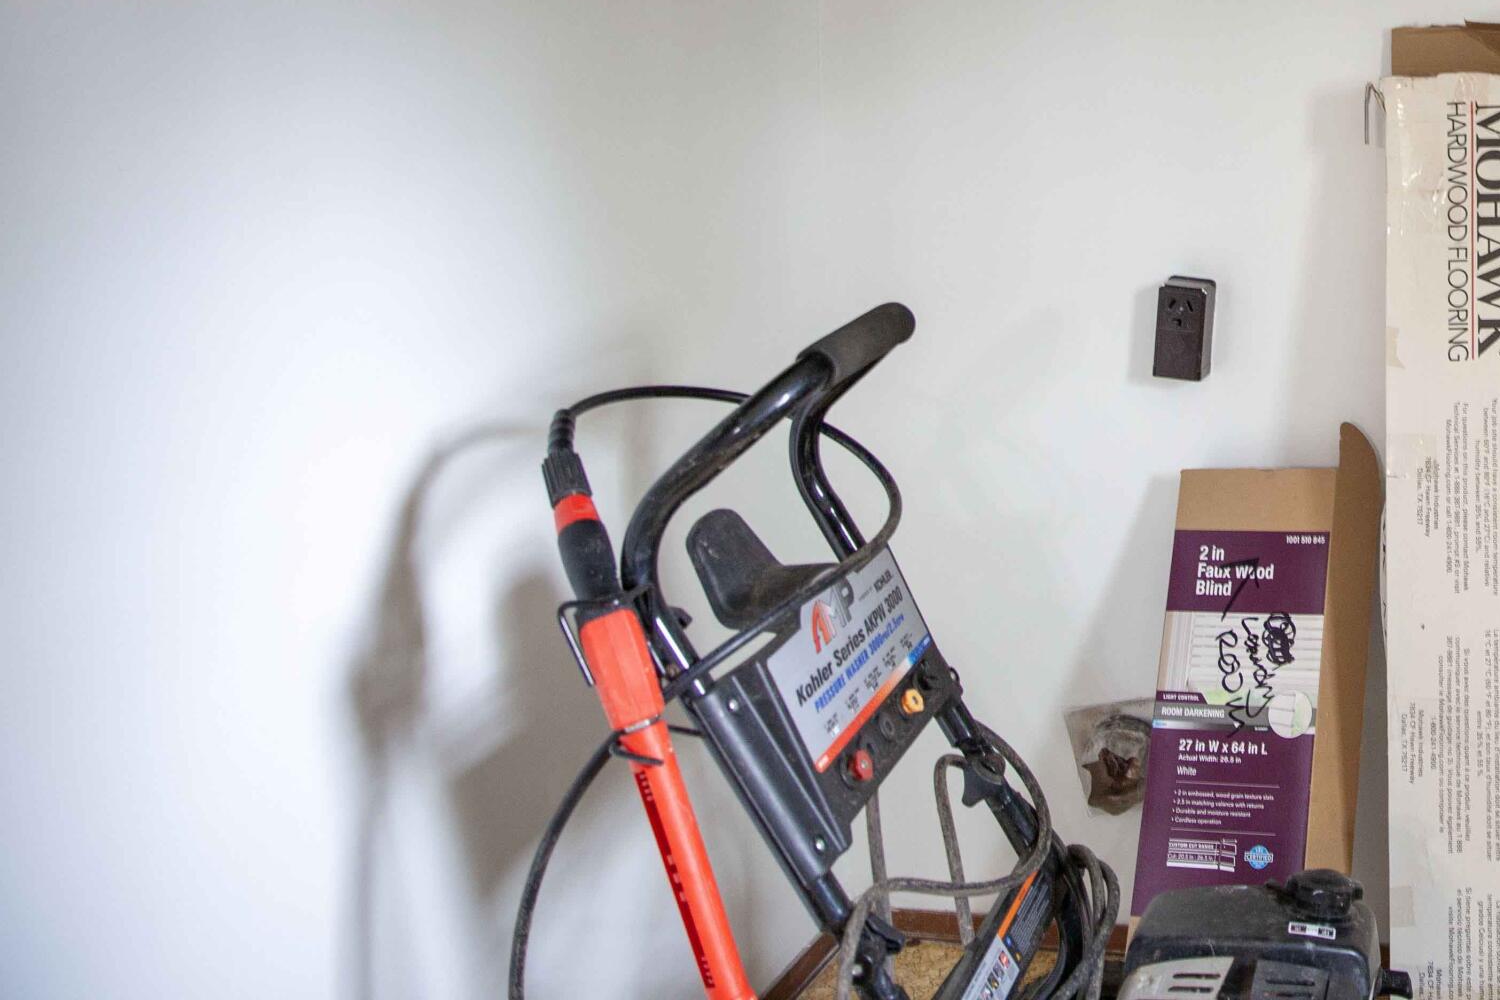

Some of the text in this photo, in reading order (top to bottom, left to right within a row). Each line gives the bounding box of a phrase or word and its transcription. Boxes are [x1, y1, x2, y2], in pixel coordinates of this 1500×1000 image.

[1446, 102, 1469, 362] HARDWOOD FLOORING
[1199, 545, 1225, 561] 2 in
[1197, 563, 1231, 579] Faux
[1196, 580, 1232, 596] Blind
[811, 573, 855, 654] AMP
[795, 664, 834, 708] Kohler
[832, 629, 867, 668] Series
[864, 601, 887, 638] AKPW
[884, 585, 904, 615] 3000
[814, 673, 846, 713] PRESSURE
[845, 649, 870, 681] WASHER
[1161, 706, 1225, 719] ROOM DARKENING
[1179, 739, 1268, 755] 27 in W x 64 in L
[1178, 754, 1198, 762] Actual
[1199, 755, 1218, 763] Width:
[1235, 756, 1242, 764] in
[1176, 765, 1197, 776] White
